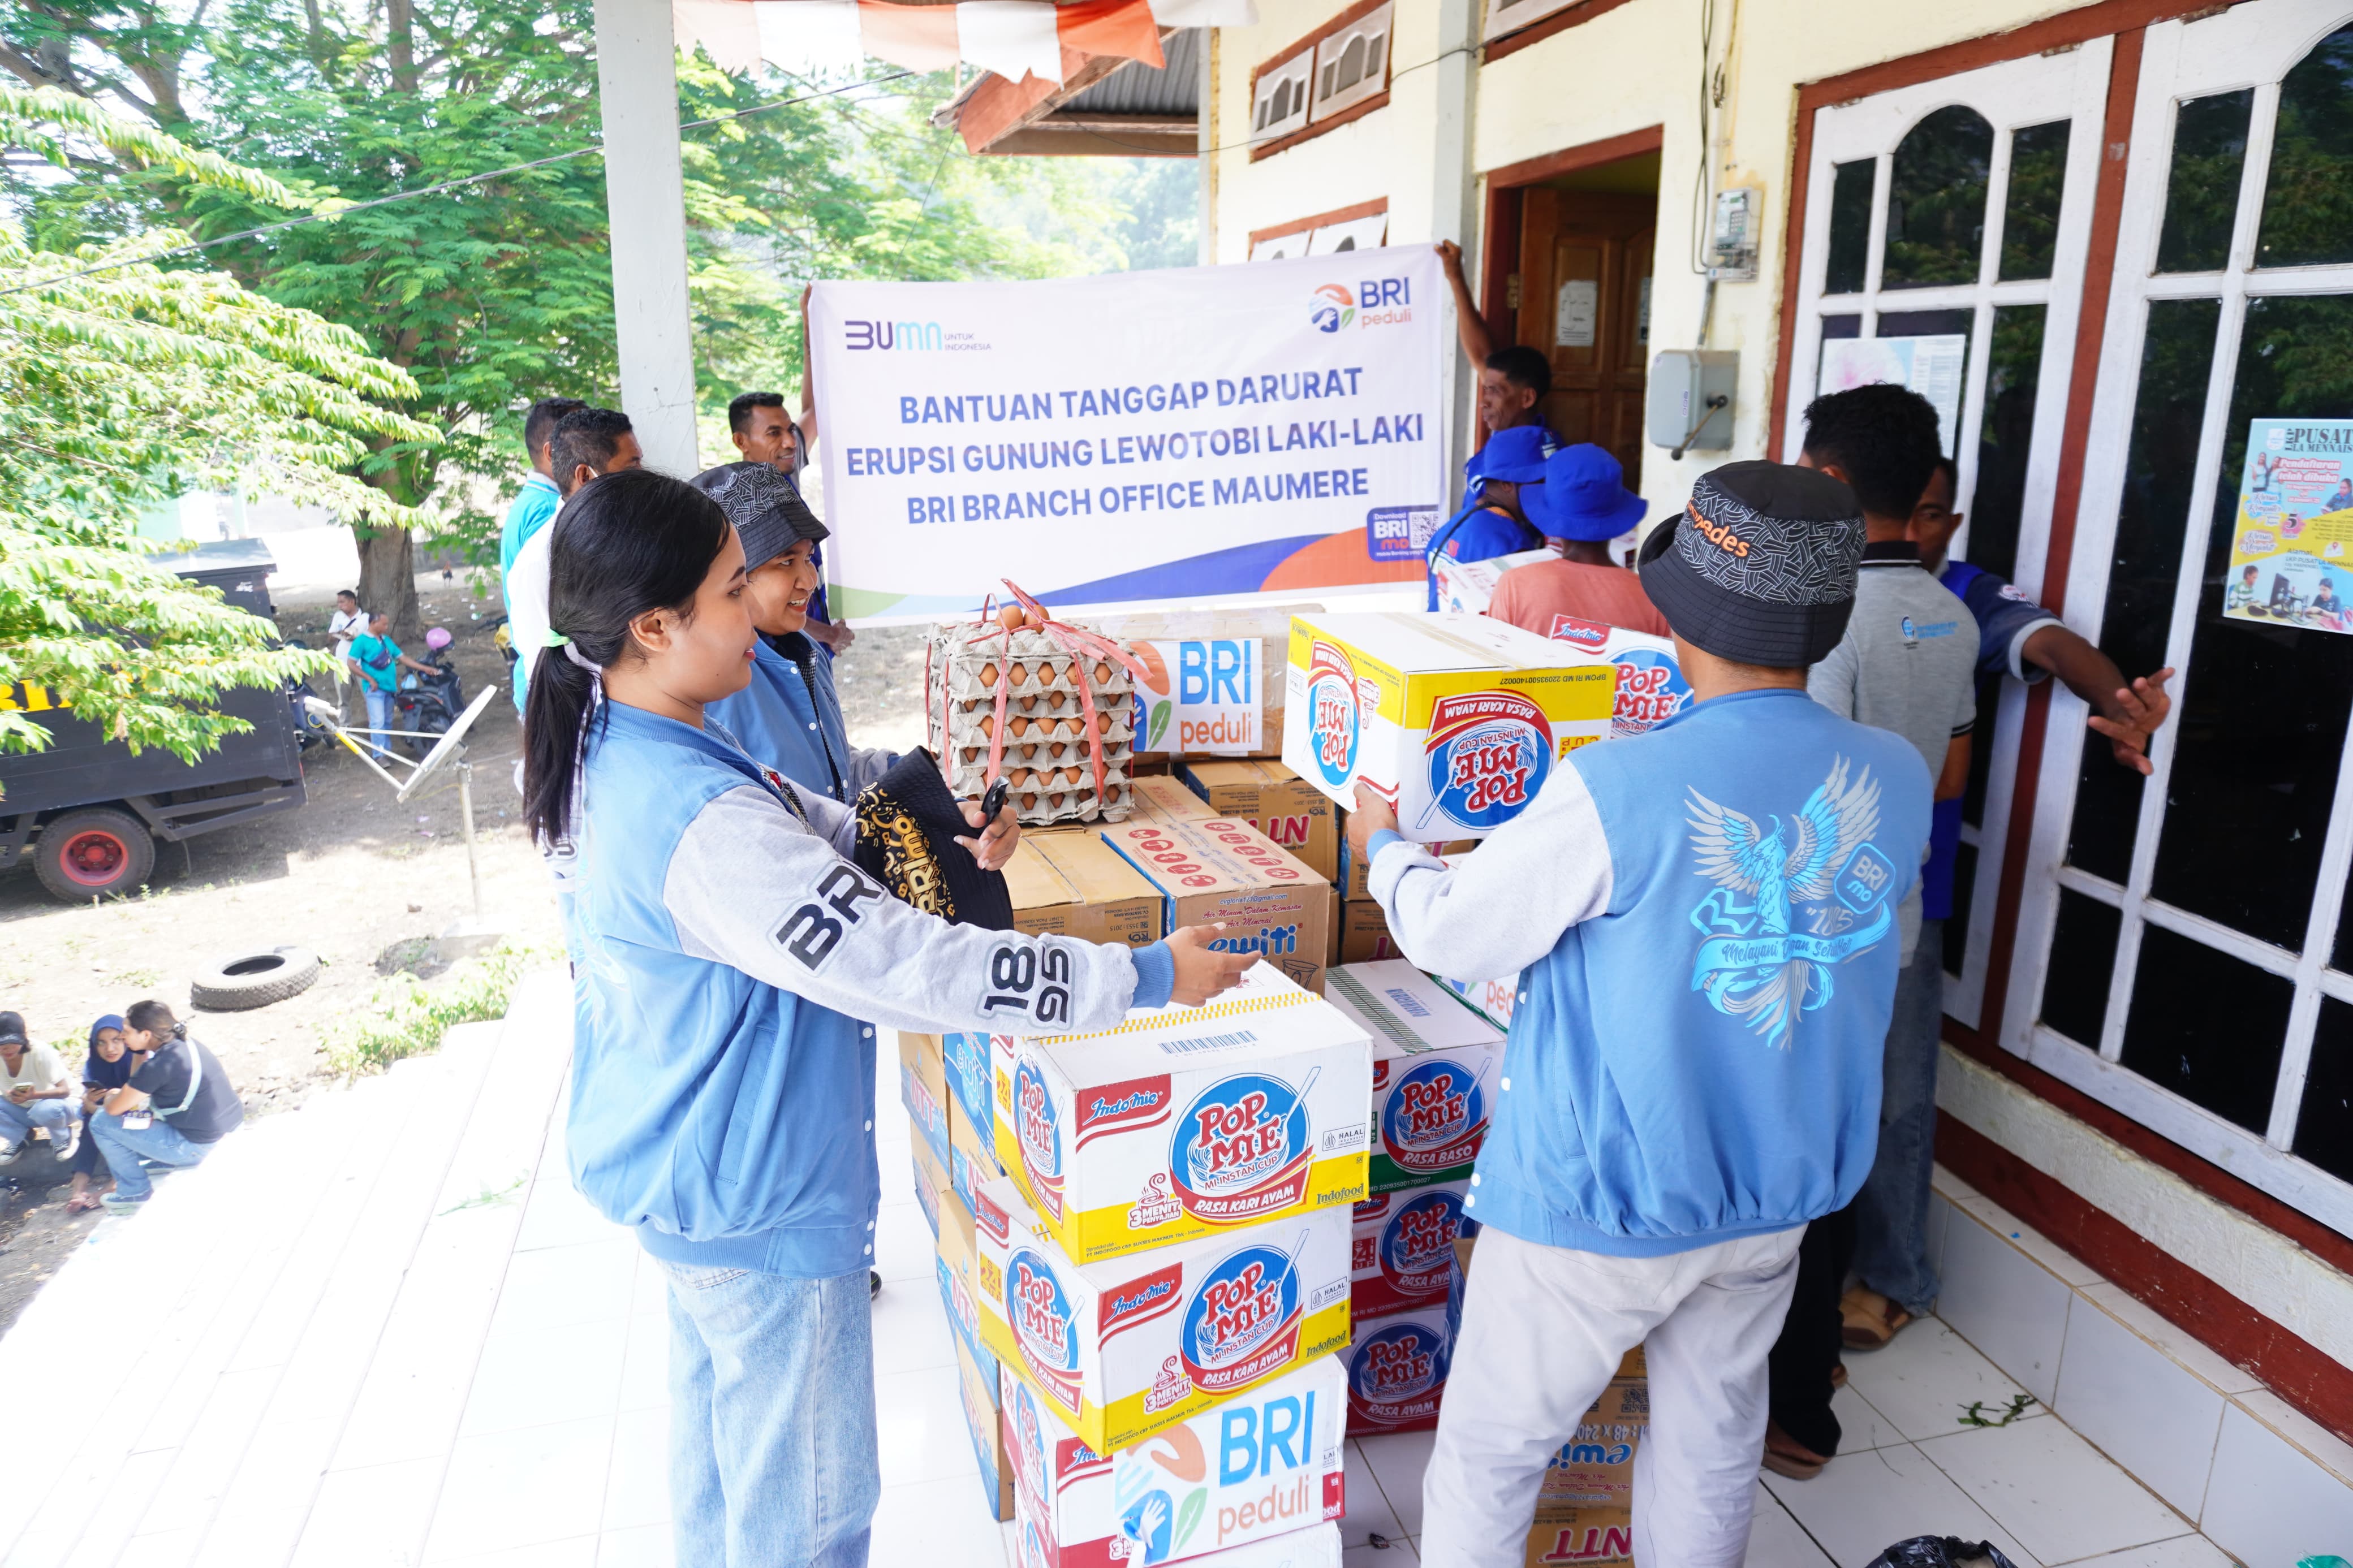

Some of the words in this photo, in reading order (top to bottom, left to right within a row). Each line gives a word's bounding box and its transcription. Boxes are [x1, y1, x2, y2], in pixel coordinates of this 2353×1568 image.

[1360, 277, 1410, 308] BRI
[1362, 308, 1411, 330] peduli
[900, 393, 1052, 424] BANTUAN
[1059, 381, 1209, 417] TANGGAP
[1217, 367, 1363, 407] DARURAT
[847, 446, 955, 476] ERUPSI
[963, 439, 1093, 472] GUNUNG
[1101, 426, 1260, 465] LEWOTOBI
[1267, 413, 1424, 452] LAKI-LAKI
[2280, 459, 2340, 470] Pendaftaran
[2304, 472, 2338, 482] dibuka
[907, 496, 955, 524] BRI
[963, 488, 1091, 521] BRANCH
[1100, 480, 1205, 513] OFFICE
[1213, 467, 1369, 506] MAUMERE
[1374, 520, 1408, 539] BRI
[2286, 513, 2298, 529] 5
[1381, 538, 1409, 550] mo
[1180, 640, 1251, 704] BRI
[1500, 676, 1561, 686] 220935001400027
[1615, 664, 1667, 694] POP
[1317, 701, 1346, 734] MIE
[1445, 702, 1476, 719] AYAM
[1476, 701, 1505, 713] KARI
[1505, 702, 1537, 719] RASA
[1613, 694, 1675, 720] MIE
[1180, 712, 1251, 752] peduli
[1459, 739, 1479, 750] CUP
[1480, 731, 1512, 745] INSTAN
[1513, 728, 1525, 736] MI
[1321, 732, 1348, 772] POP
[1455, 742, 1522, 788] MIE
[1466, 767, 1529, 813] POP
[1852, 855, 1887, 891] BRI
[1220, 894, 1287, 905] cvgloria123@gmail.com
[1846, 880, 1872, 901] mo
[775, 853, 887, 971] BR
[1202, 910, 1217, 919] Air
[1218, 909, 1243, 917] Minum
[1244, 906, 1269, 914] Dalam
[1226, 919, 1240, 928] Air
[1243, 917, 1273, 926] Mineral
[1722, 940, 1778, 965] Melayani
[1020, 1073, 1045, 1118] POP
[1403, 1075, 1451, 1116] POP
[1197, 1093, 1265, 1148] POP
[1410, 1093, 1464, 1134] MIE
[1026, 1109, 1051, 1155] MIE
[1209, 1117, 1281, 1173] MIE
[1338, 1129, 1364, 1139] HALAL
[1417, 1130, 1444, 1144] INSTAN
[1446, 1124, 1462, 1134] CUP
[1402, 1152, 1437, 1165] RASA
[1438, 1146, 1473, 1163] BASO
[1023, 1154, 1035, 1181] RASA
[1034, 1176, 1046, 1198] KARI
[1045, 1191, 1058, 1212] AYAM
[1204, 1178, 1217, 1190] MI
[1219, 1166, 1256, 1185] INSTAN
[1257, 1156, 1278, 1169] CUP
[1194, 1201, 1227, 1213] RASA
[1229, 1196, 1259, 1212] KARI
[1261, 1185, 1295, 1206] AYAM
[1316, 1183, 1365, 1205] Indofood
[1130, 1209, 1143, 1228] 3
[1142, 1200, 1179, 1217] MENIT
[1143, 1211, 1180, 1225] PENYAJIAN
[1399, 1203, 1447, 1241] POP
[1086, 1243, 1106, 1252] Diproduksi
[1094, 1246, 1121, 1255] INDOFOOD
[1133, 1239, 1151, 1247] SUKSES
[1152, 1234, 1174, 1243] MAKMUR
[1406, 1219, 1456, 1258] MIE
[1018, 1264, 1054, 1310] POP
[1205, 1263, 1262, 1326] POP
[1324, 1282, 1346, 1296] HALAL
[1398, 1275, 1429, 1286] RASA
[1025, 1302, 1065, 1347] MIE
[1214, 1282, 1276, 1347] MIE
[1210, 1354, 1222, 1364] MI
[1224, 1334, 1255, 1356] INSTAN
[1256, 1320, 1274, 1334] CUP
[1305, 1331, 1347, 1358] Indofood
[1368, 1336, 1417, 1371] POP
[1019, 1343, 1038, 1370] RASA
[1037, 1365, 1055, 1386] KARI
[1055, 1383, 1075, 1404] AYAM
[1202, 1371, 1231, 1385] RASA
[1232, 1362, 1259, 1380] KARI
[1259, 1343, 1288, 1368] AYAM
[1376, 1353, 1429, 1388] MIE
[1146, 1396, 1156, 1413] 3
[1156, 1379, 1190, 1401] MENIT
[1156, 1388, 1190, 1408] PENYAJIAN
[1411, 1380, 1427, 1389] CUP
[1367, 1403, 1398, 1416] RASA
[1400, 1401, 1434, 1416] AYAM
[1114, 1431, 1139, 1446] INDOFOOD
[1149, 1419, 1165, 1430] SUKSES
[1166, 1411, 1185, 1424] MAKMUR
[1219, 1390, 1315, 1488] BRI
[1218, 1474, 1309, 1545] peduli
[1546, 1527, 1632, 1561] NTT
